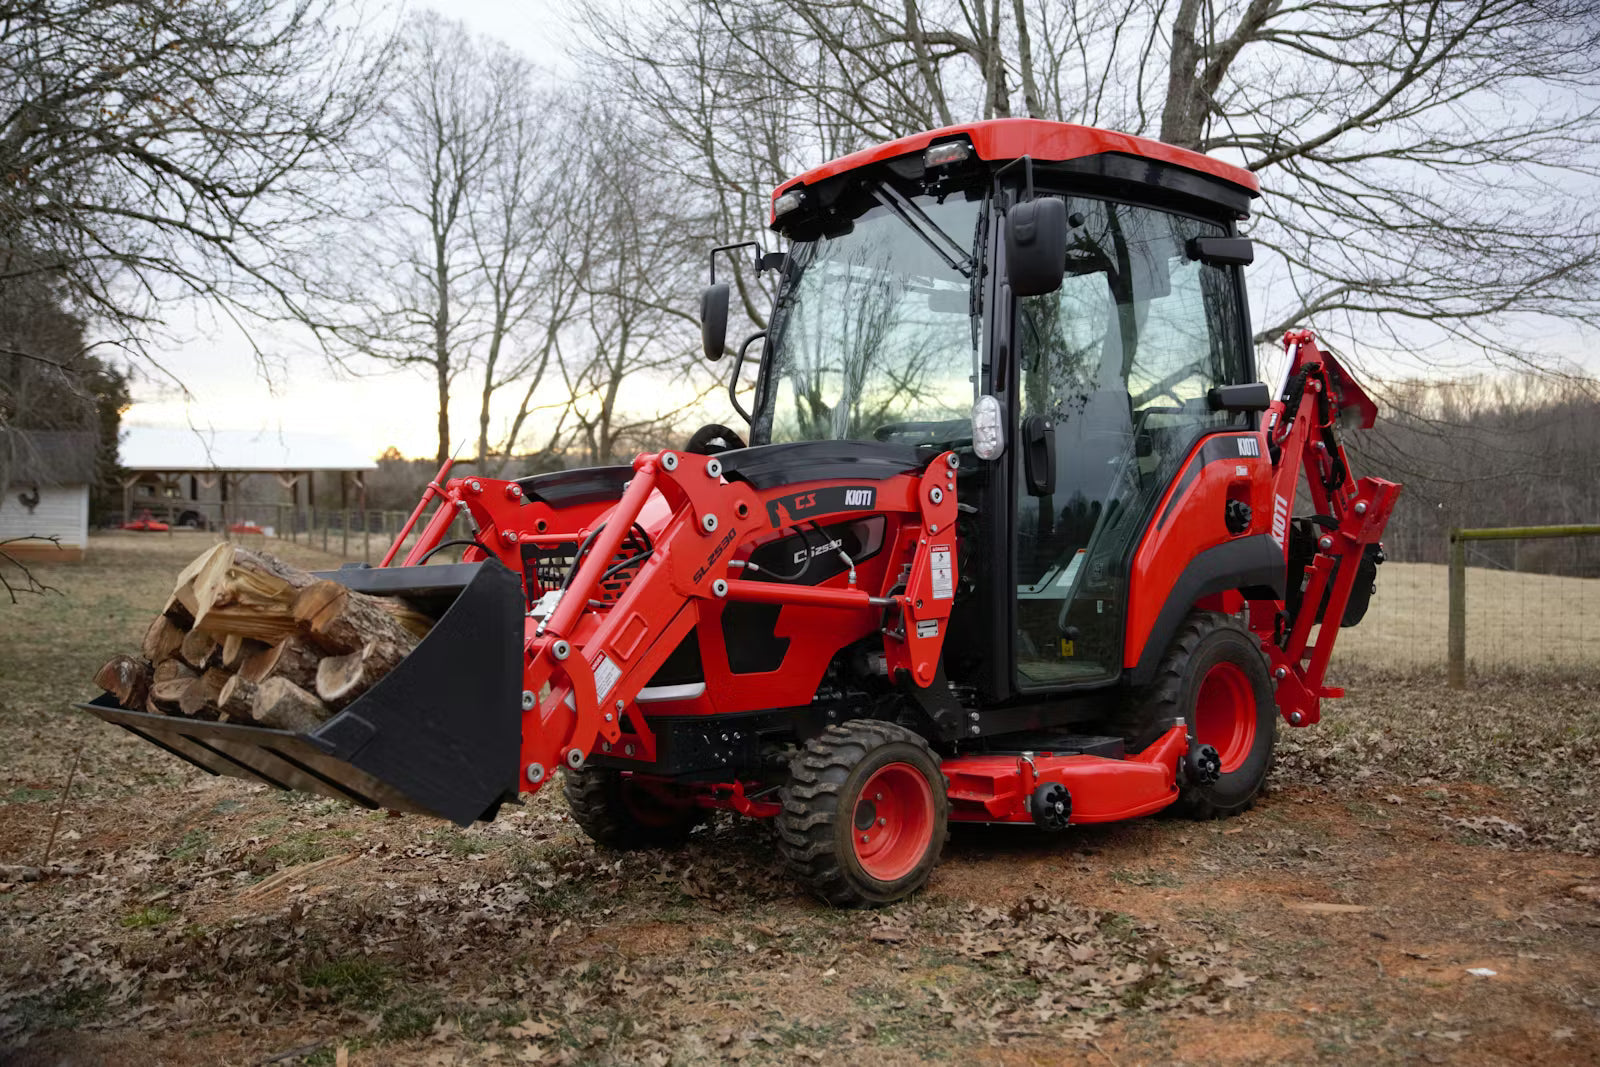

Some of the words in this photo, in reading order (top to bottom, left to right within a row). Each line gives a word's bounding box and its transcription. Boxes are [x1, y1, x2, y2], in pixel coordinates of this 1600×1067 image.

[1237, 437, 1259, 457] KIOTI
[794, 494, 817, 510] CS
[845, 490, 873, 506] KIOTI
[1272, 494, 1288, 550] KIOTI
[693, 528, 737, 585] SL2530
